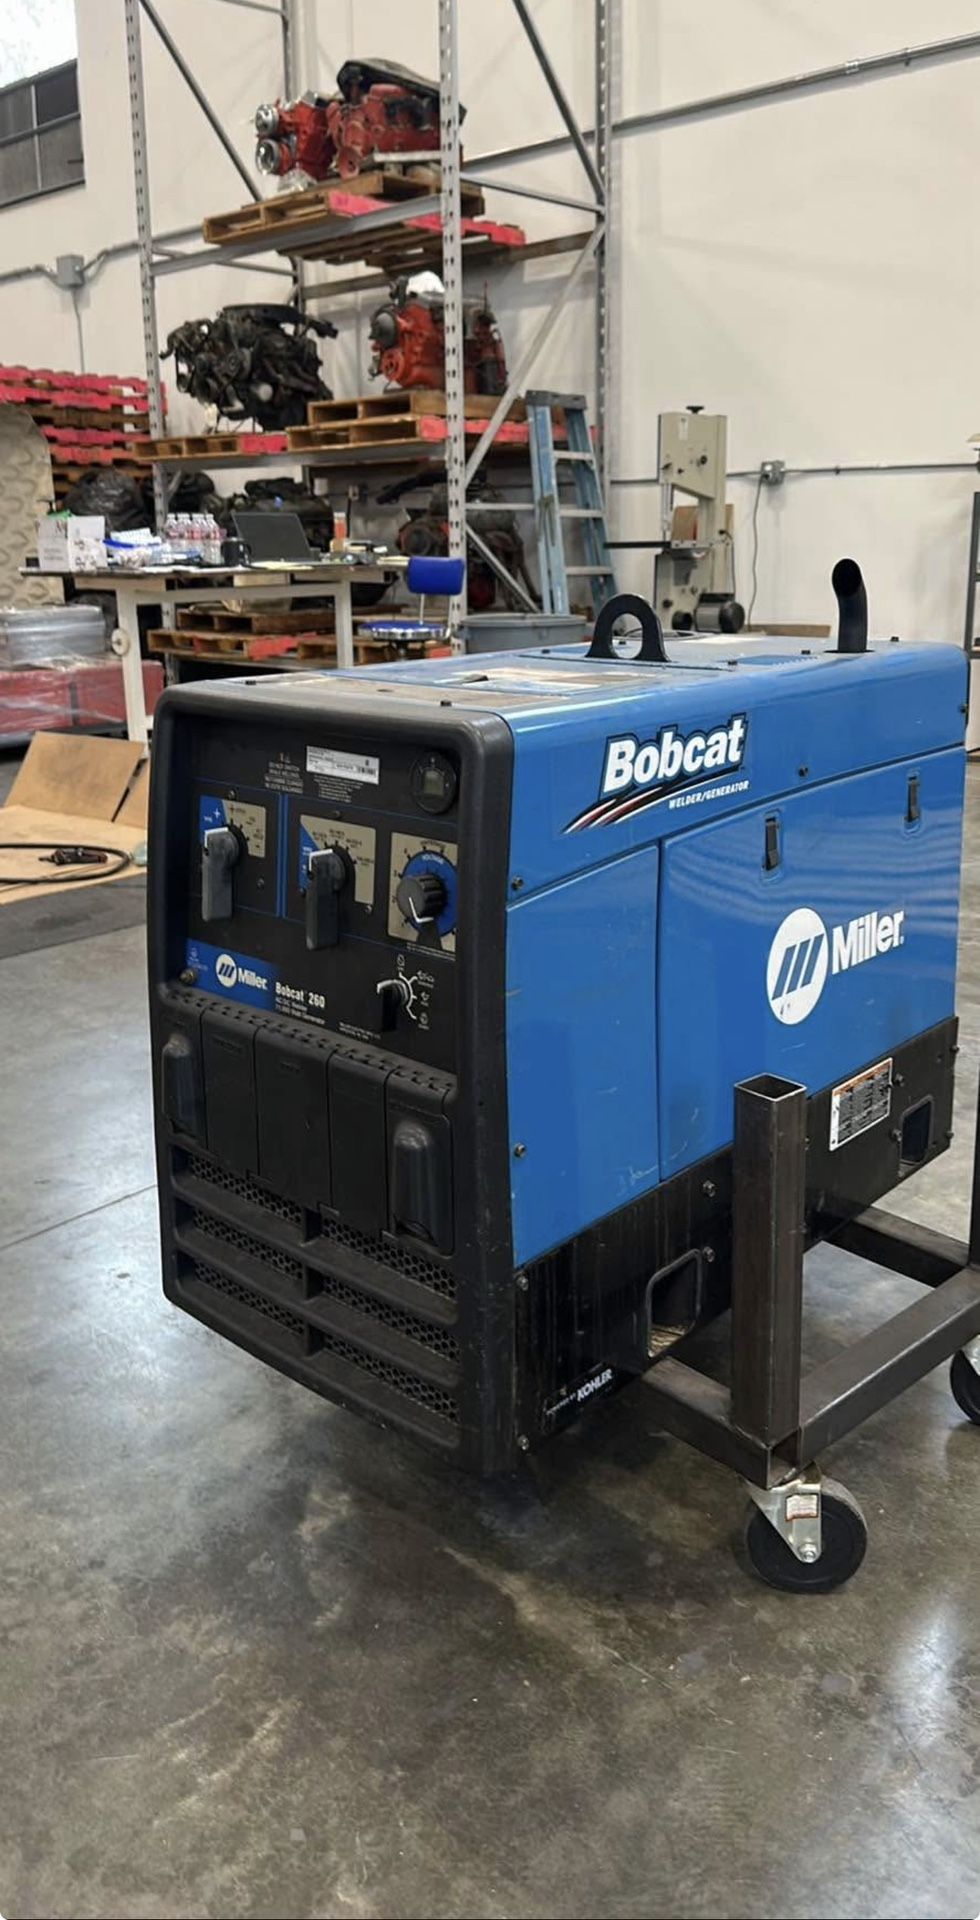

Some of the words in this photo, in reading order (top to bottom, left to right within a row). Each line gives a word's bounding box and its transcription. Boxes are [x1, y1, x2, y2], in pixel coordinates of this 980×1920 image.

[603, 717, 746, 793] Bobcat
[668, 780, 749, 809] WELDER/GENERATOR
[832, 910, 904, 975] Miller
[238, 967, 267, 990] Miller
[275, 981, 305, 1002] Bobcat
[308, 992, 325, 1009] 260
[577, 1369, 612, 1402] KOHLER
